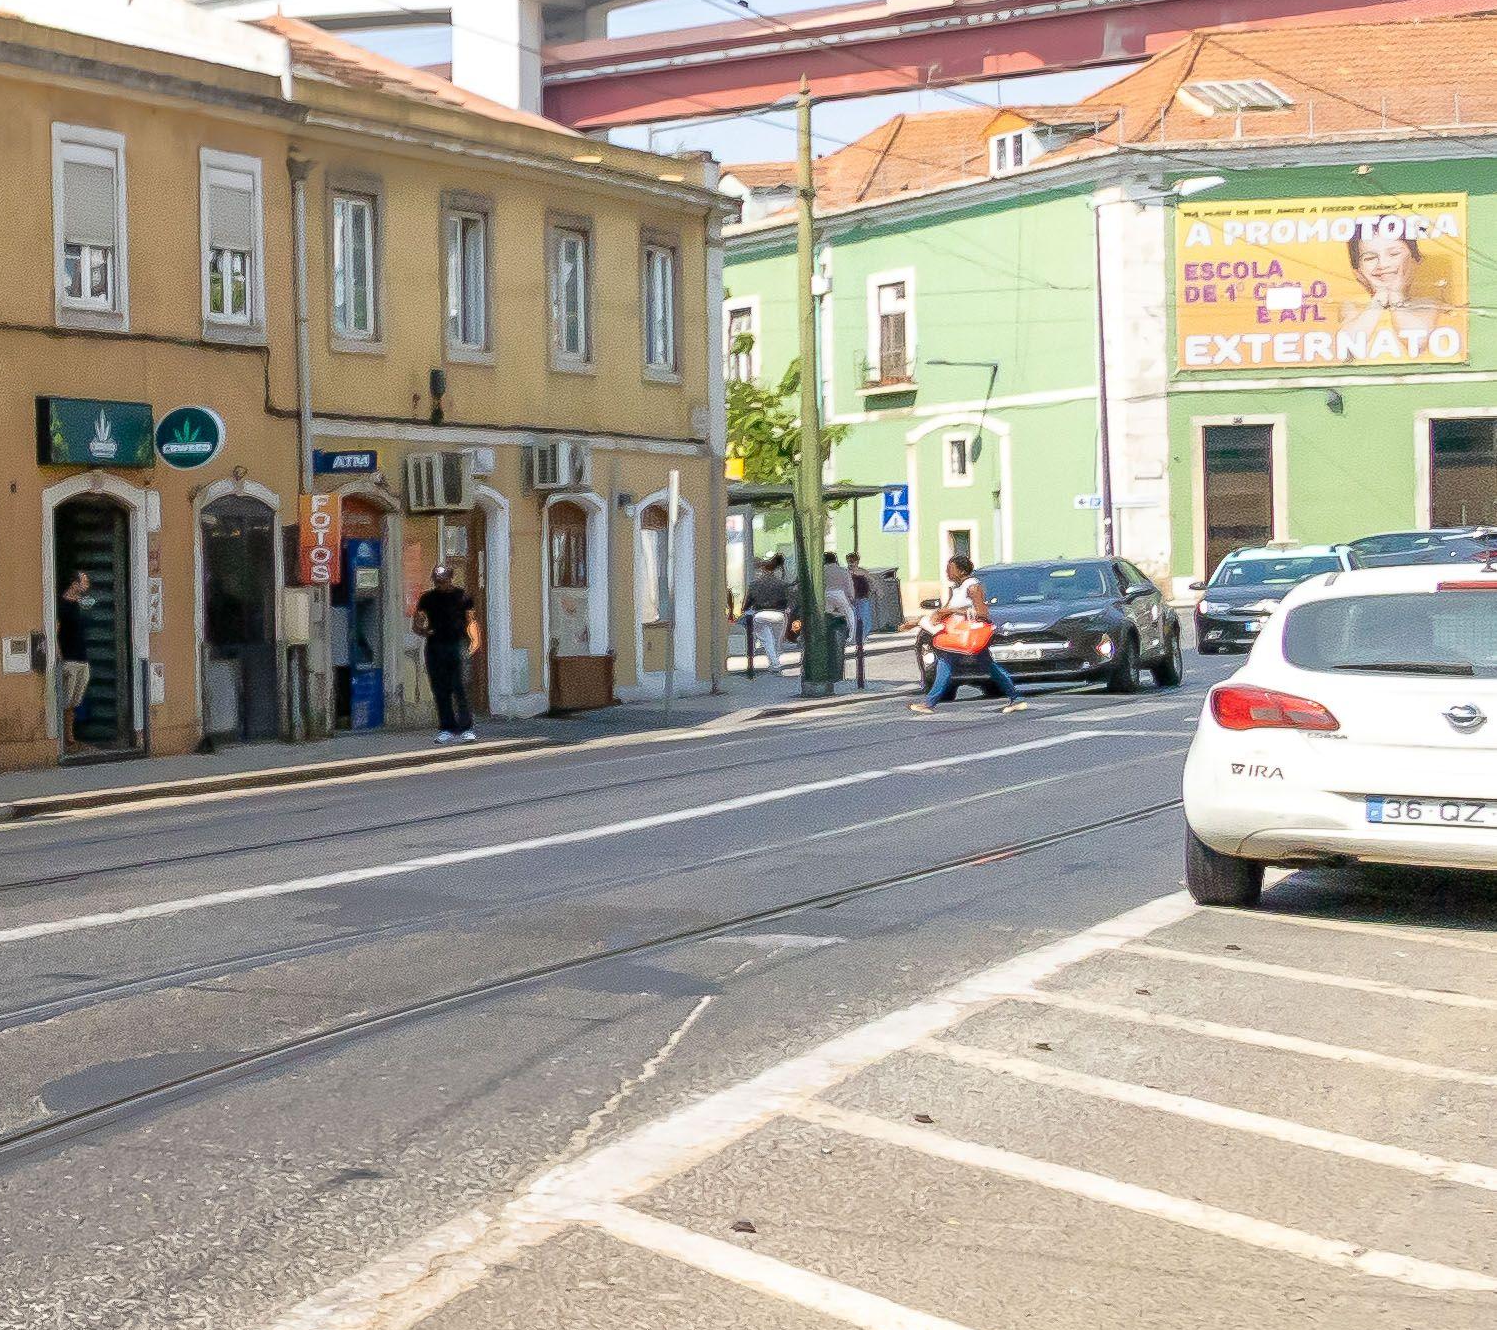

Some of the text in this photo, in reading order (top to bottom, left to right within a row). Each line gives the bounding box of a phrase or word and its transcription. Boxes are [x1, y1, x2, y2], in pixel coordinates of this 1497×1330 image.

[1184, 213, 1459, 247] A PROMOTORA
[1184, 260, 1283, 281] ESCOLA
[1184, 284, 1217, 303] DE
[1257, 305, 1271, 323] E
[1184, 326, 1460, 365] EXTERNATO
[311, 495, 331, 582] FOTOS
